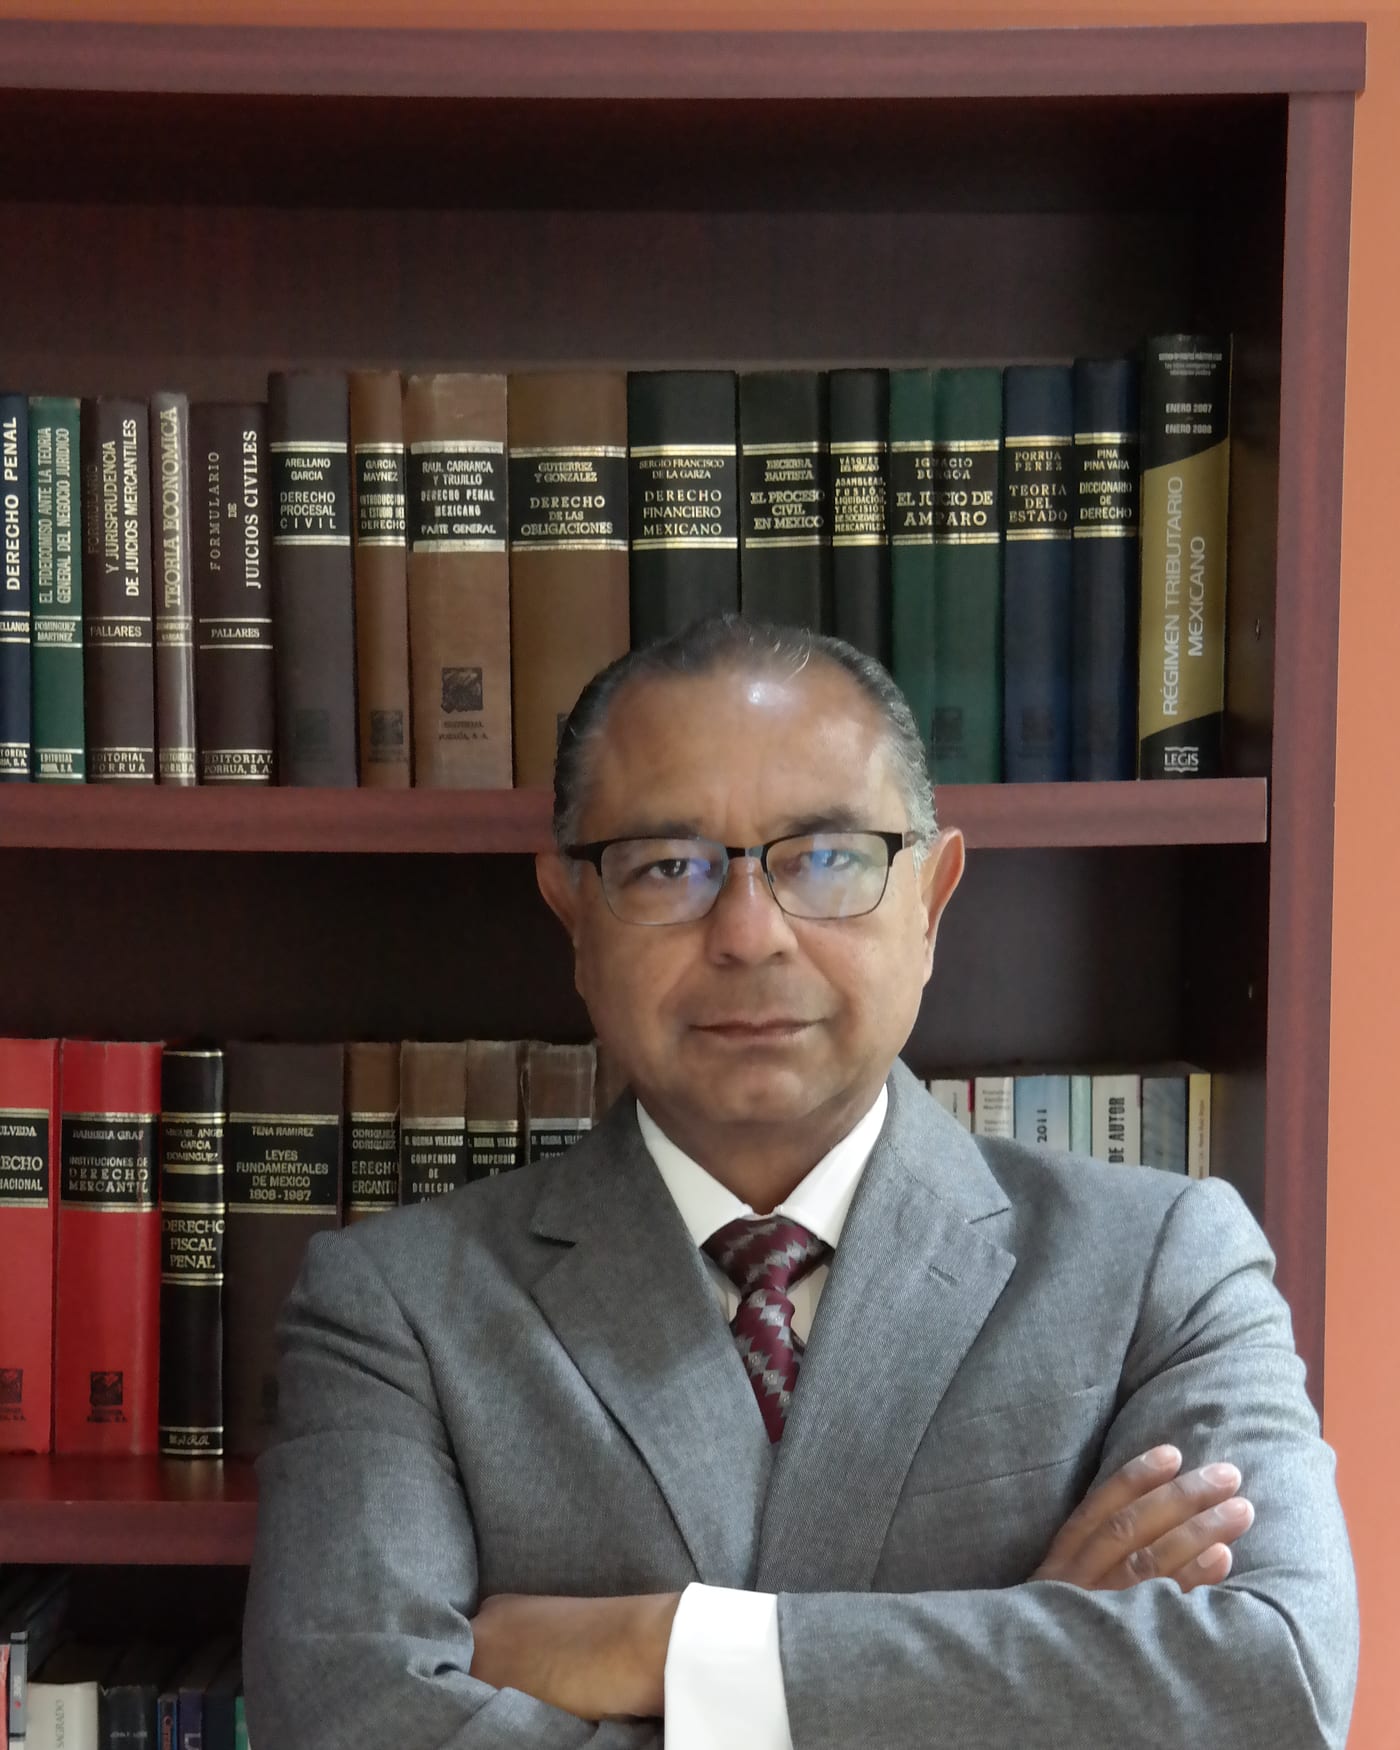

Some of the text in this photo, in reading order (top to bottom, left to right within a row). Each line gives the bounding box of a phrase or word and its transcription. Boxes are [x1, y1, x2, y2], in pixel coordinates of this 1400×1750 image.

[1165, 403, 1192, 414] ENERO
[1165, 424, 1192, 434] ENERO
[1014, 450, 1062, 461] PORRUA
[1096, 448, 1118, 459] PINA
[160, 406, 179, 531] ECONOMICA
[285, 458, 331, 468] ARELLANO
[366, 459, 397, 470] GARCIA
[538, 462, 593, 472] GUTIERREZ
[640, 458, 724, 469] SERGIO FRANCISCO
[914, 457, 974, 468] IGACIO
[1014, 460, 1062, 472] PEREZ
[1084, 460, 1105, 471] PINA
[290, 470, 324, 480] GARCIA
[363, 472, 399, 482] MAYNEZ
[433, 474, 482, 486] Y TRUJILLO
[534, 472, 598, 483] Y GONZALEZ
[652, 470, 712, 480] DE LA GARZA
[764, 470, 814, 482] BAUTISTA
[917, 469, 972, 480] BUGOA
[1008, 483, 1067, 496] TEORIA
[1079, 480, 1132, 494] DICCIONARIO
[280, 491, 336, 503] DERECHO
[421, 488, 496, 502] DERECHO PENAL
[644, 489, 722, 502] DERECHO
[750, 490, 825, 504] EL PROCESO
[896, 490, 994, 506] EL JUCIO DE
[1100, 495, 1112, 506] DE
[3, 417, 20, 590] DERECHO PENAL
[56, 480, 70, 528] NEGOCIO
[102, 440, 120, 574] Y JURISPRUDENCIA
[123, 418, 140, 597] DE JUICIOS MERCANTILES
[530, 495, 606, 509] DERECHO
[1024, 497, 1053, 510] DEL
[38, 427, 52, 604] EL FIDEICOMISO ANTE LA TEORIA
[208, 452, 220, 571] FORMULARIO
[228, 502, 238, 518] DE
[243, 430, 262, 590] JUICIOS CIVILES
[280, 504, 336, 516] PROCESAL
[434, 504, 482, 518] MEXICANO
[548, 510, 584, 521] DE LAS
[643, 505, 722, 518] FINANCIERO
[772, 503, 806, 516] CIVIL
[1080, 507, 1132, 520] DERECHO
[754, 515, 824, 530] EN MEXICO
[1008, 510, 1068, 523] ESTADO
[280, 517, 336, 530] CIVIL
[361, 520, 406, 530] DERECHO
[421, 524, 496, 535] PARTE GENERAL
[520, 521, 614, 536] OBLIGACIONES
[644, 522, 722, 536] MEXICANO
[56, 530, 70, 552] DEL
[1165, 476, 1184, 608] TRIBUTARIO
[164, 534, 180, 608] TEORIA
[56, 555, 71, 604] GENERAL
[1188, 536, 1206, 657] MEXICANO
[34, 622, 76, 632] DOMINGUEZ
[90, 625, 142, 638] PALLARES
[211, 628, 260, 638] PALLARES
[37, 632, 73, 642] MARTINEZ
[204, 754, 272, 764] EDITORIAL
[1164, 752, 1199, 767] LEGIS
[252, 1126, 314, 1137] TENA RAMIREZ
[1036, 1108, 1048, 1143] 2011
[1108, 1096, 1125, 1164] DE AUTOR
[117, 1130, 144, 1140] GRAF
[352, 1128, 396, 1139] ODRIGUEZ
[180, 1140, 212, 1150] GARCIA
[352, 1140, 396, 1150] ODRIGUEZ
[434, 1135, 464, 1146] VILLEGAS
[265, 1149, 298, 1161] LEYES
[410, 1153, 456, 1165] COMPENDIO
[472, 1154, 516, 1165] COMPENDIO
[0, 1156, 44, 1172] ECHO
[69, 1156, 148, 1168] INSTITUCIONES DE
[236, 1161, 329, 1175] FUNDAMENTALES
[352, 1160, 399, 1175] ERECH
[69, 1168, 149, 1181] DERECHO
[428, 1168, 439, 1179] DE
[68, 1180, 149, 1193] MERCANTIL
[252, 1175, 311, 1188] DE MEXICO
[162, 1219, 225, 1234] DERECHO
[170, 1237, 216, 1251] FISCAL
[170, 1254, 216, 1269] PENAL
